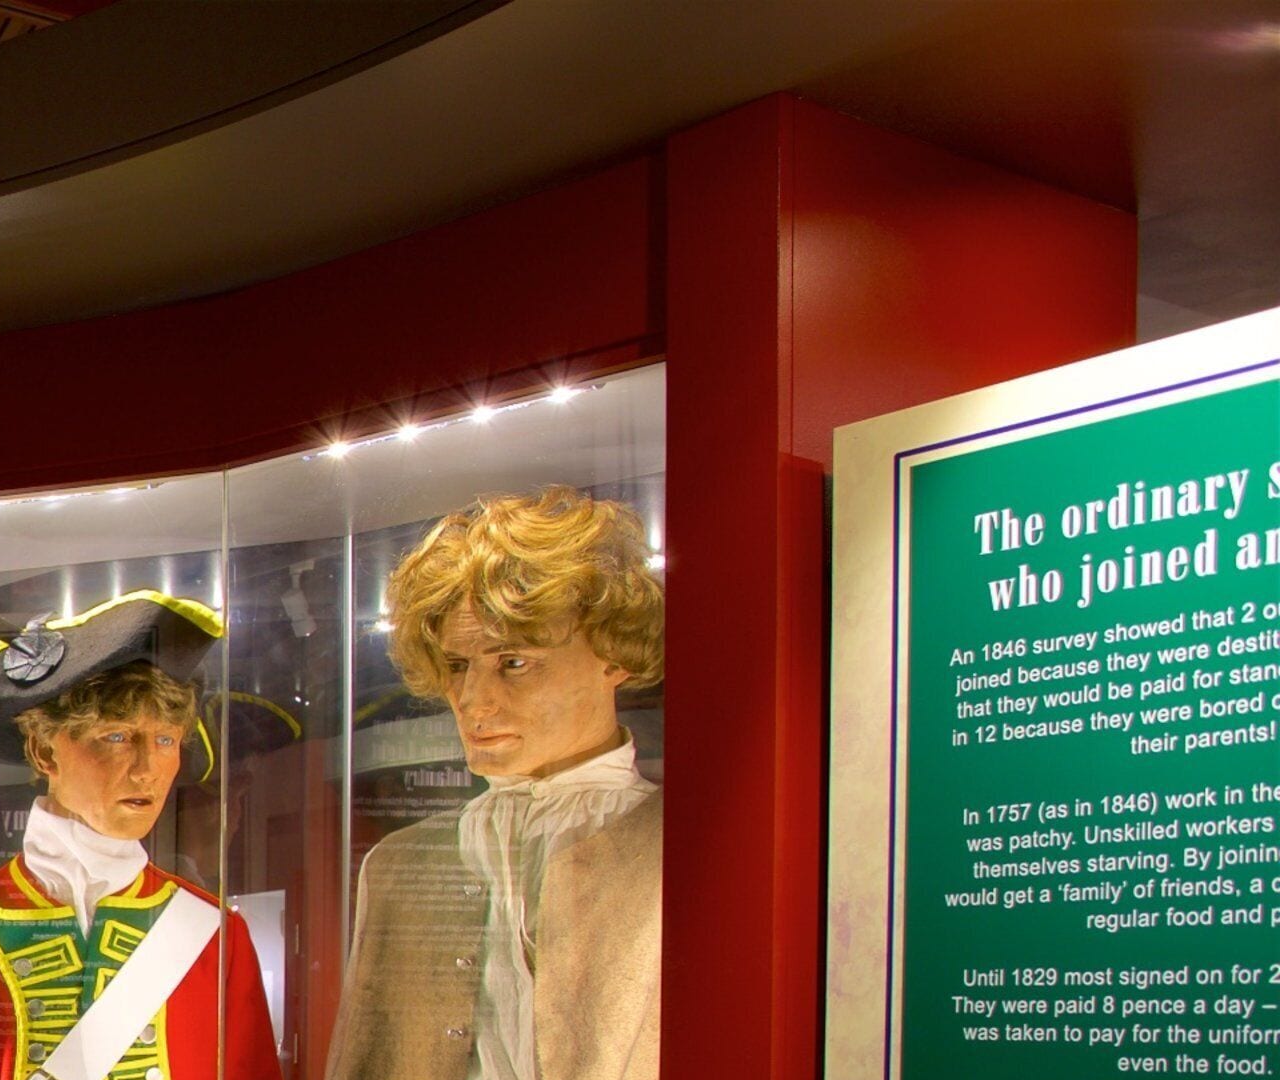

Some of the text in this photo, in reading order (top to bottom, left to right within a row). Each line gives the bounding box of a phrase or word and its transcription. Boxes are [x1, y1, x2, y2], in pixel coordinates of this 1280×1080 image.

[974, 507, 1046, 555] The
[1061, 468, 1250, 539] ordinary
[988, 563, 1064, 612] who
[1076, 527, 1219, 609] joined
[949, 648, 976, 667] An
[982, 637, 1028, 662] 1846
[1032, 631, 1098, 655] survey
[1103, 613, 1186, 644] showed
[1191, 606, 1235, 631] that
[1241, 601, 1257, 624] 2
[955, 667, 1012, 697] joined
[1017, 659, 1101, 685] because
[1106, 651, 1152, 673] they
[1156, 642, 1211, 665] were
[956, 698, 992, 720] that
[997, 695, 1038, 716] they
[1043, 682, 1102, 708] would
[1107, 681, 1134, 701] be
[1140, 671, 1187, 701] paid
[1192, 668, 1223, 690] for
[952, 729, 969, 747] in
[975, 724, 998, 744] 12
[1002, 717, 1084, 741] because
[1090, 710, 1135, 733] they
[1139, 704, 1193, 725] were
[1199, 691, 1265, 719] bored
[1130, 720, 1277, 755] their parents!
[963, 968, 1005, 987] Until
[1012, 967, 1058, 987] 1829
[1064, 968, 1113, 987] most
[1119, 965, 1189, 990] signed
[1195, 968, 1224, 985] on
[1231, 963, 1263, 985] for
[951, 994, 1256, 1019] They were paid 8 pence a day
[962, 1026, 1000, 1041] was
[1005, 1023, 1058, 1042] taken
[1063, 1025, 1083, 1043] to
[1089, 1027, 1126, 1047] pay
[1132, 1023, 1162, 1043] for
[1167, 1023, 1202, 1044] the
[1117, 1053, 1272, 1076] even the food.
